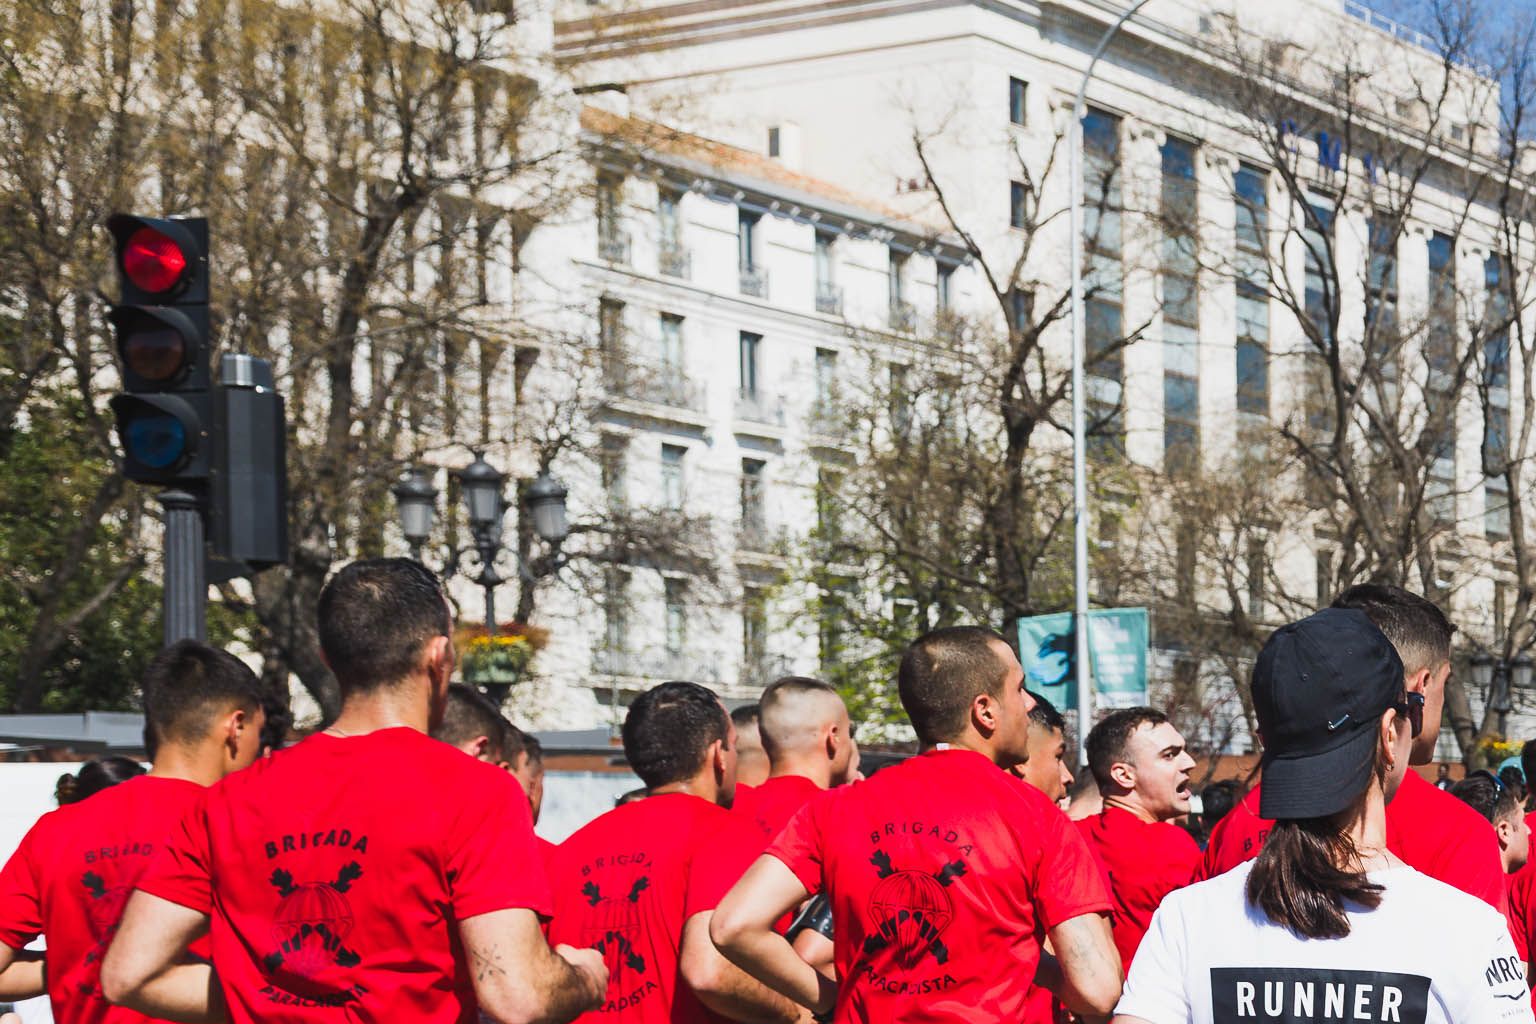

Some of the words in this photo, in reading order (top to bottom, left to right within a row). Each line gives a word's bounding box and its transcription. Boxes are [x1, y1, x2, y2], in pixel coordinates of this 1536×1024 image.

[265, 829, 369, 859] BRIGADA
[870, 822, 974, 857] BRIGADA
[1485, 955, 1523, 987] NRC
[1235, 981, 1403, 1023] RUNNER
